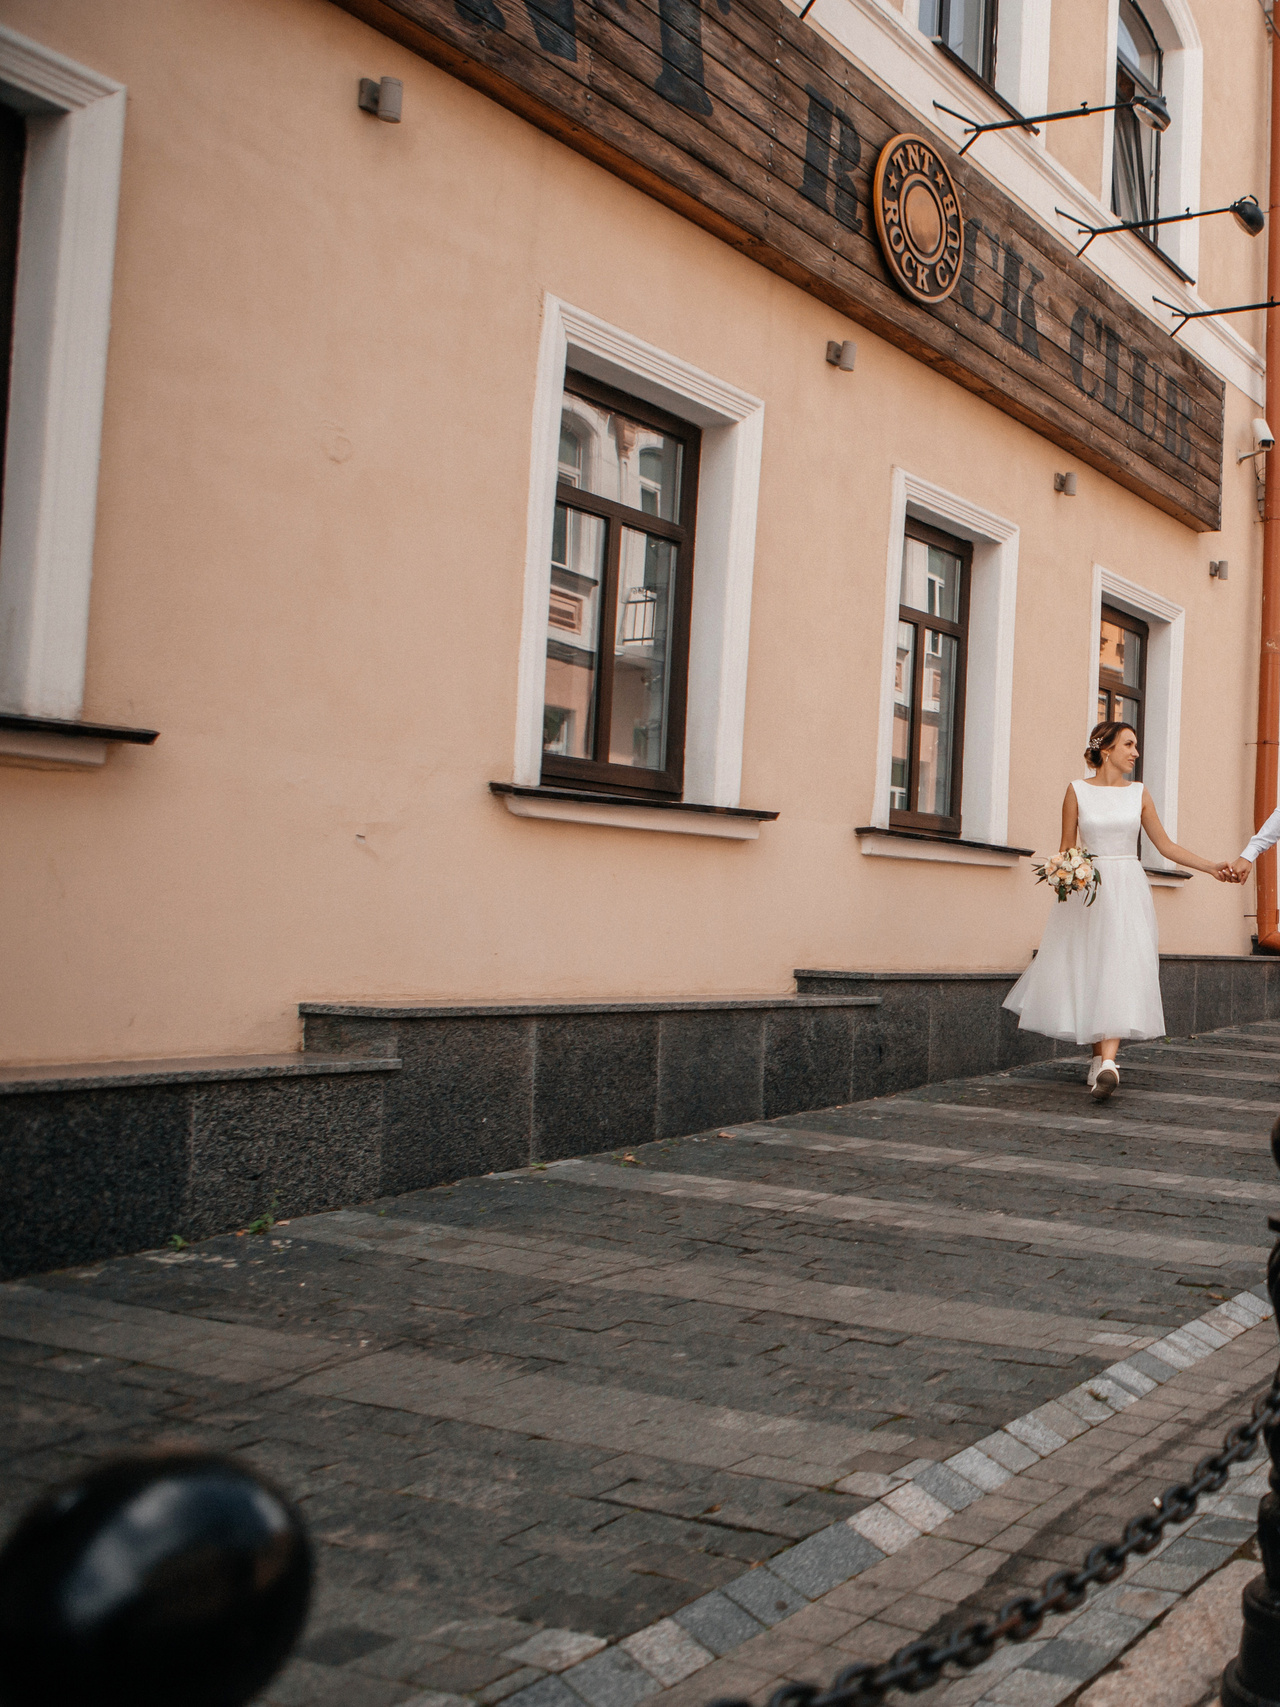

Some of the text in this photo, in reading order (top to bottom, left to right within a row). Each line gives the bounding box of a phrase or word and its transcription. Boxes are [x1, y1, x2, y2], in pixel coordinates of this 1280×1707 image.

[891, 144, 934, 178] TNT
[883, 193, 960, 293] ROCK CLUB
[1069, 305, 1193, 464] CLUB
